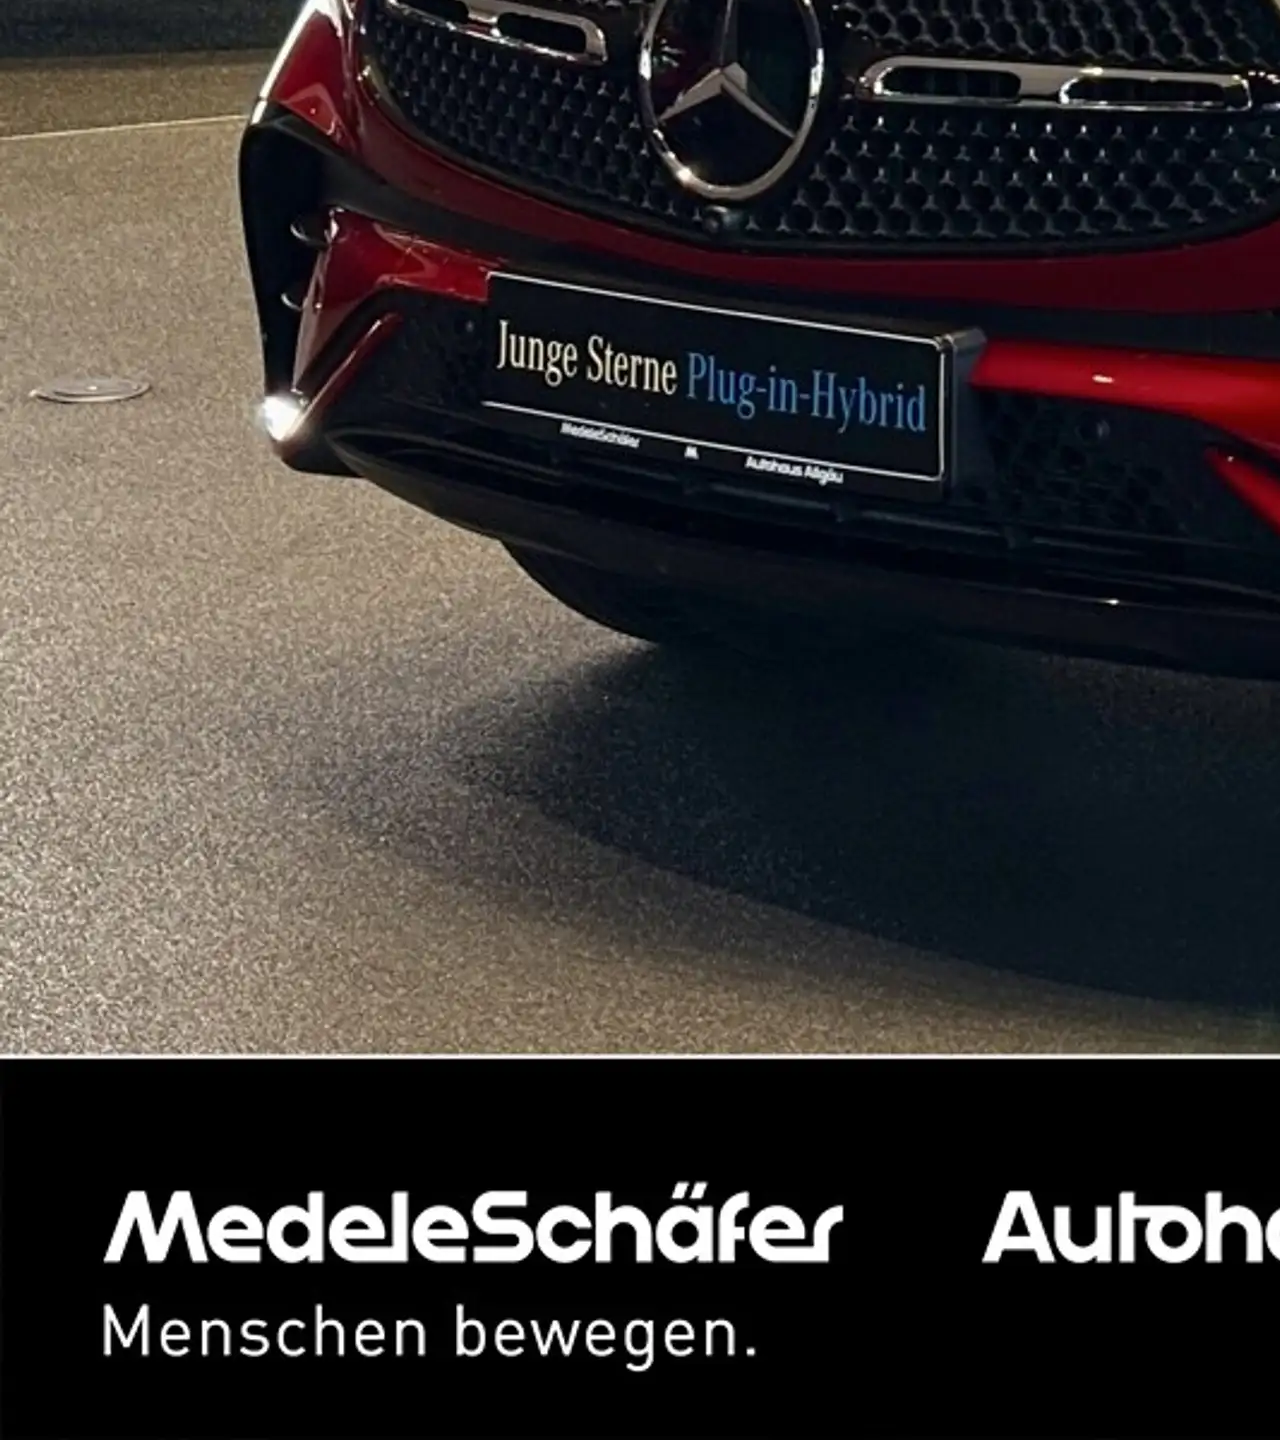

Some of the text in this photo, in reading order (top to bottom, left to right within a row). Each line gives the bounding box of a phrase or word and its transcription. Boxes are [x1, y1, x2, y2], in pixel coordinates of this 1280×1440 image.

[496, 319, 928, 435] Junge Sterne Plug-in-Hybrid
